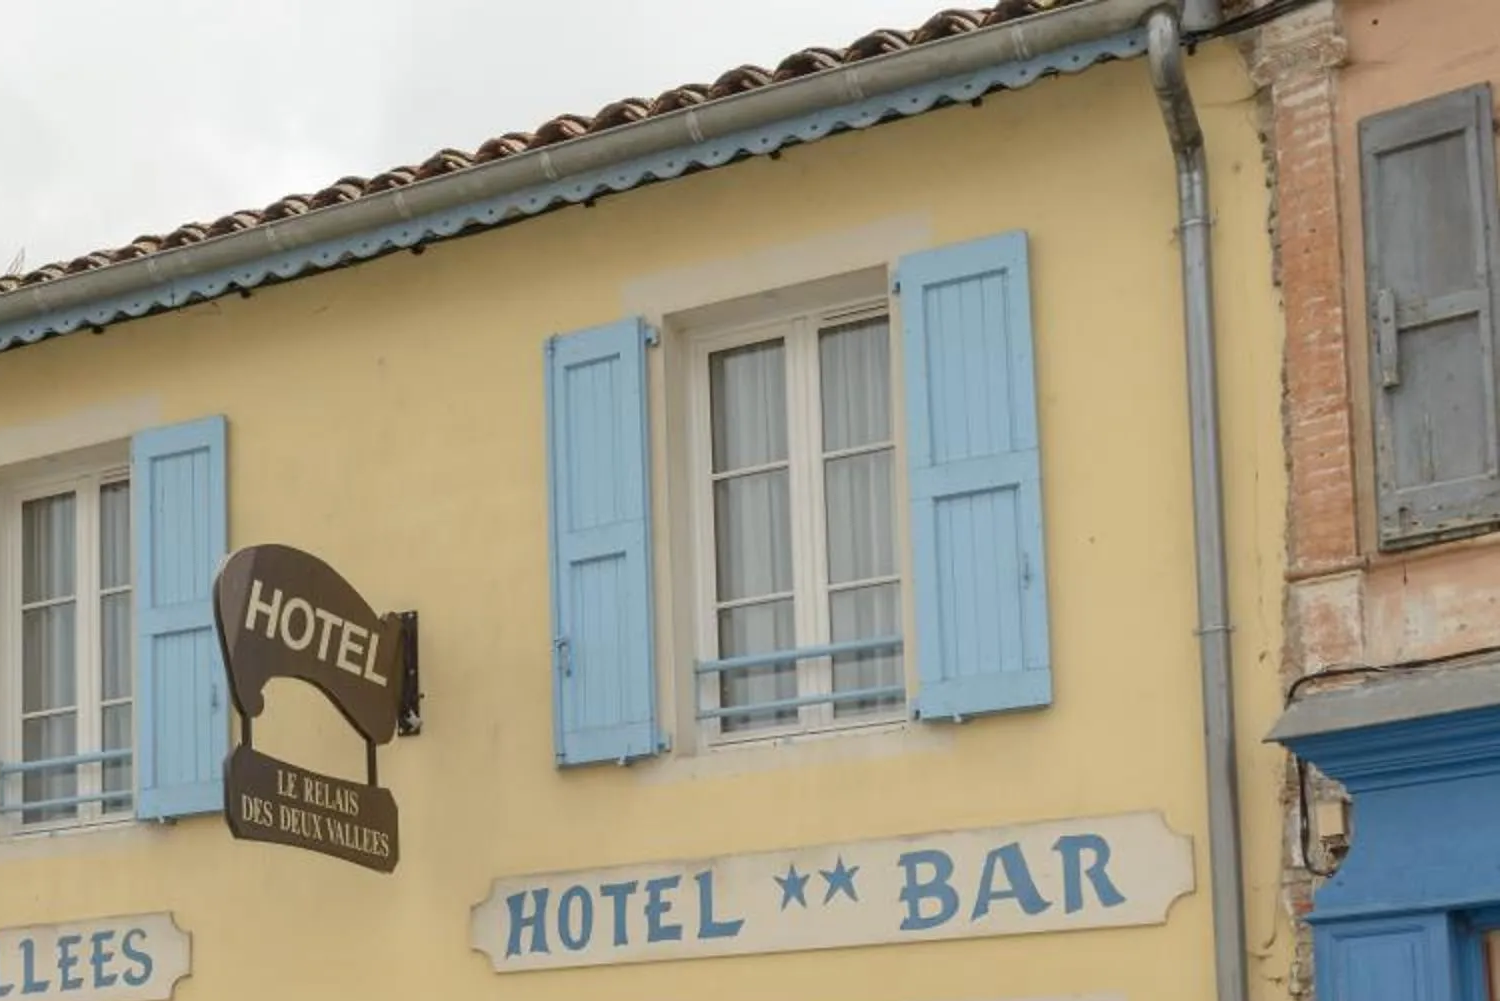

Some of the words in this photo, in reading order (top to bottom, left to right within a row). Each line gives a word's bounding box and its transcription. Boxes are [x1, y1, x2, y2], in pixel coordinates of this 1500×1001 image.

[244, 578, 388, 688] HOTEL
[241, 793, 273, 828] DES
[279, 804, 323, 842] DEUX
[326, 816, 390, 858] VALLEES
[276, 769, 298, 799] LE
[303, 776, 360, 817] RELAIS
[504, 867, 745, 960] HOTEL
[898, 833, 1127, 932] BAR
